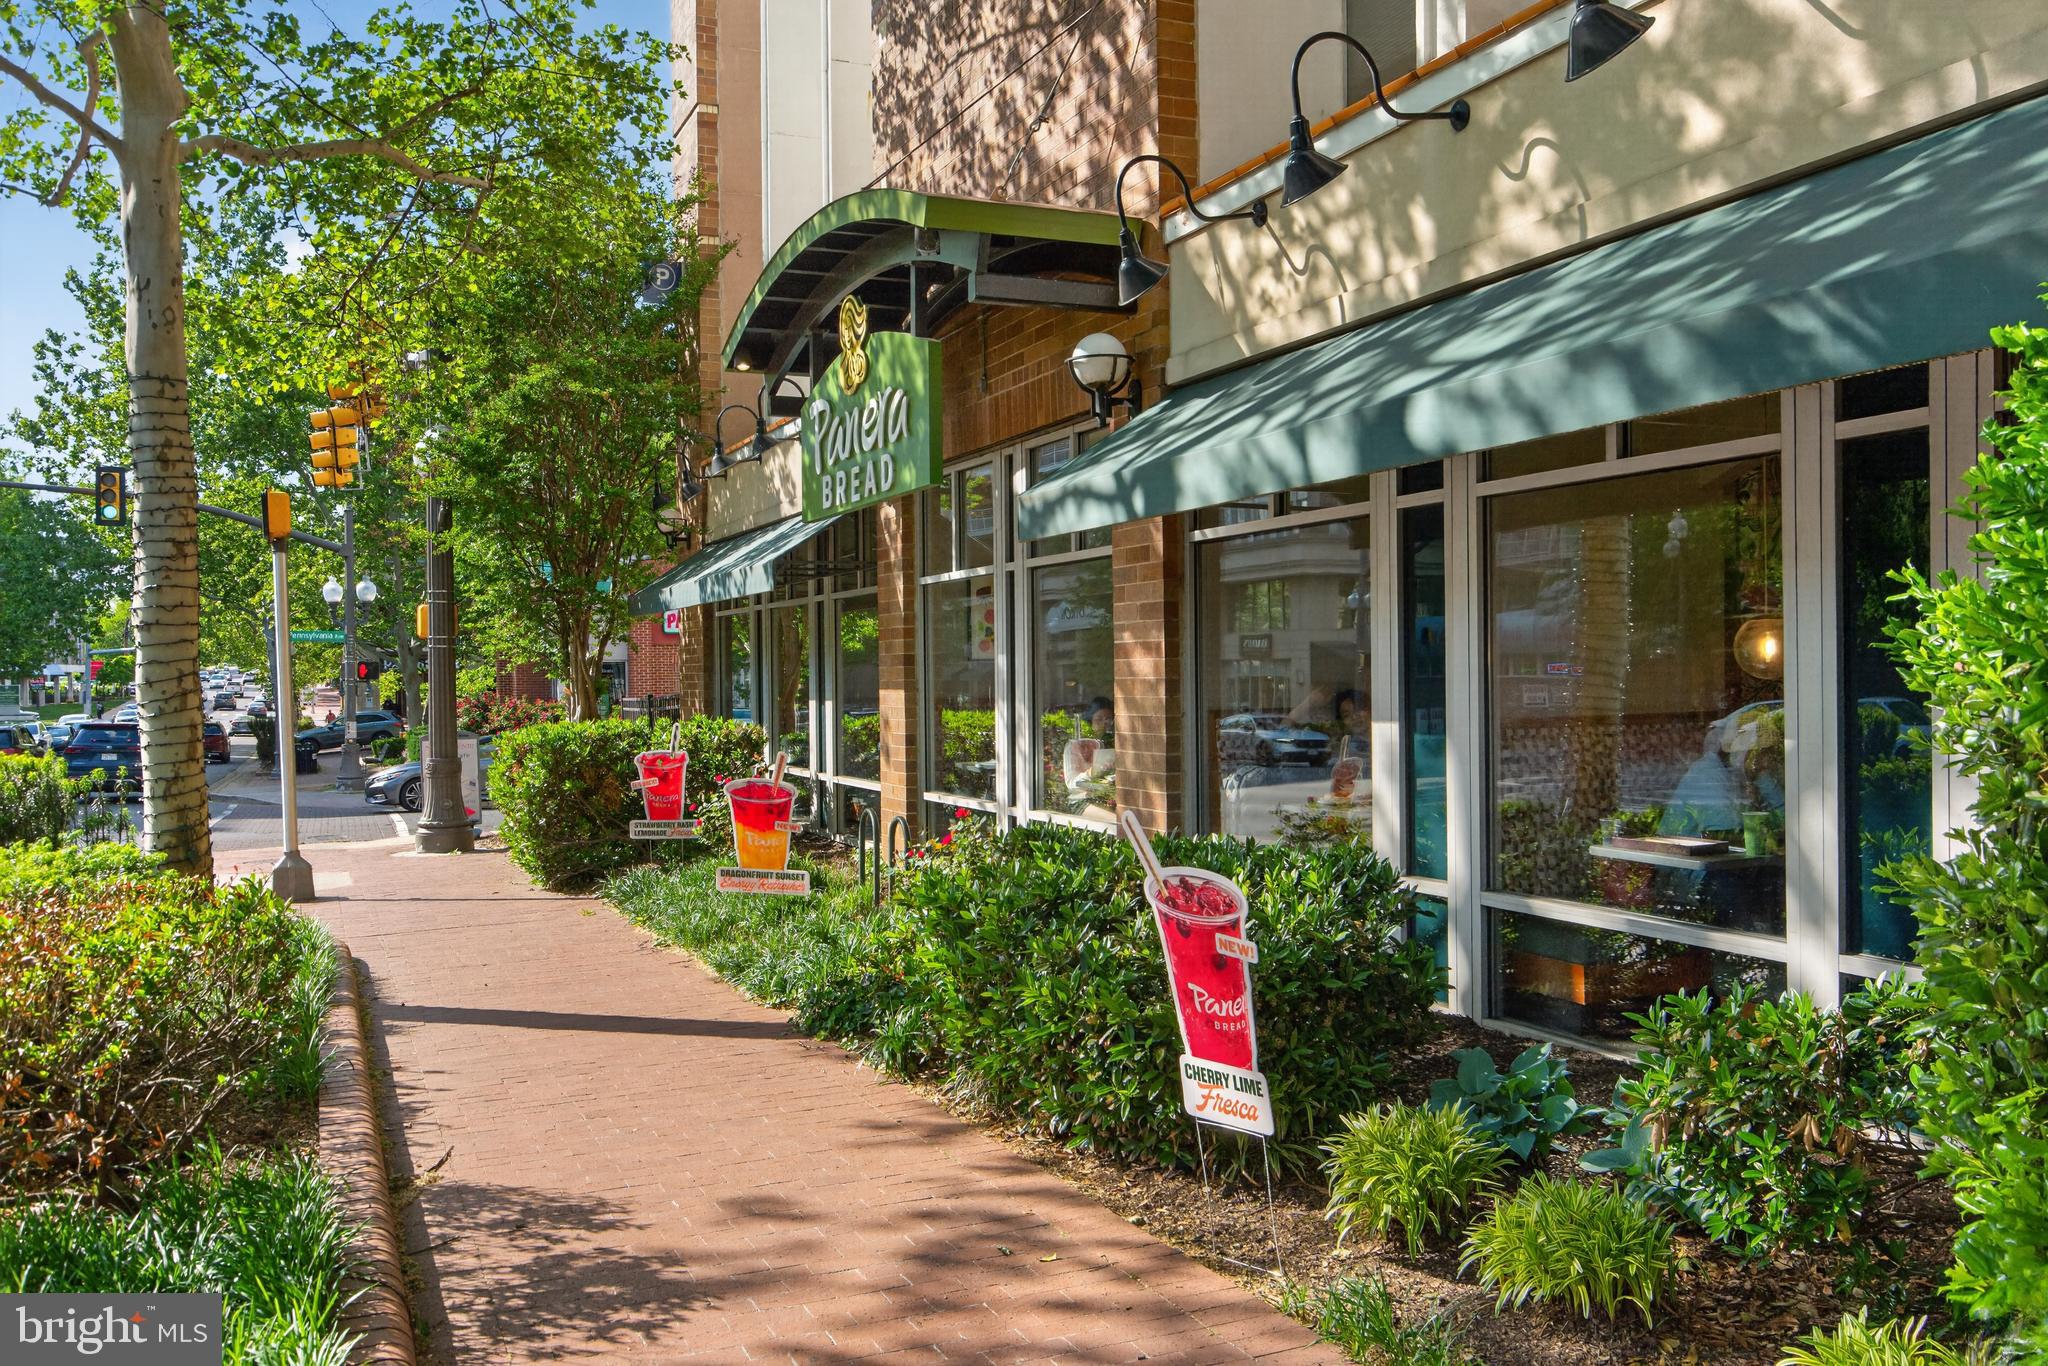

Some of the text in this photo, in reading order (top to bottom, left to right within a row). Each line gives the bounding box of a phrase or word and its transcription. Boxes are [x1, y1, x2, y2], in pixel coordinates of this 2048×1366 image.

[809, 386, 908, 475] Panera
[822, 453, 895, 510] BREAD
[667, 613, 679, 629] P
[720, 869, 806, 881] DRAGONFRUIT SUNSET
[1218, 937, 1255, 960] NEW!
[1214, 1019, 1246, 1031] BREAD
[1184, 1063, 1264, 1098] CHERRY LIME
[1195, 1081, 1259, 1122] Fresca
